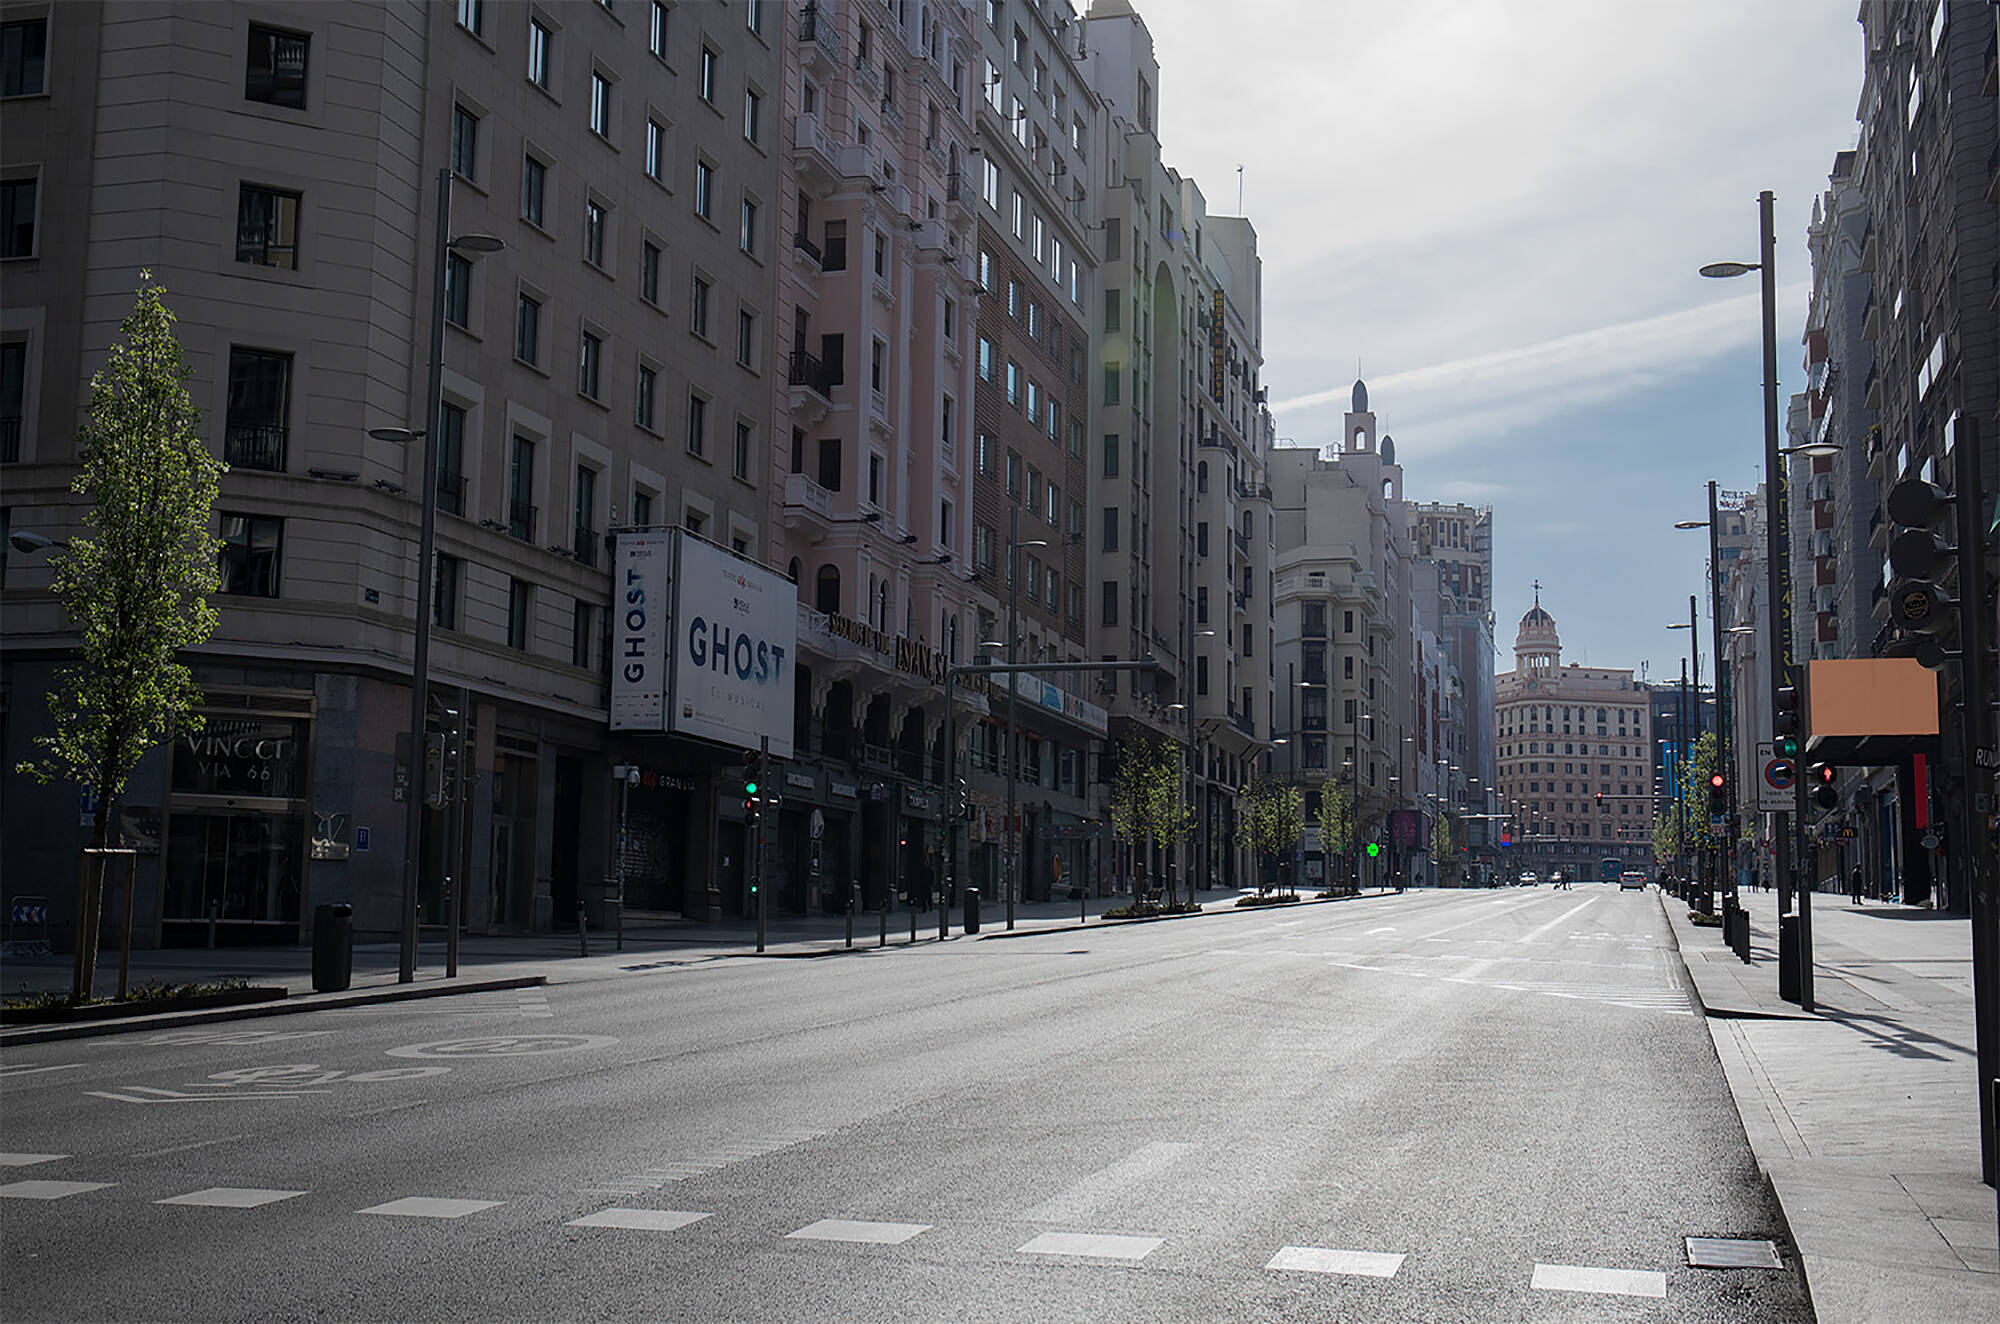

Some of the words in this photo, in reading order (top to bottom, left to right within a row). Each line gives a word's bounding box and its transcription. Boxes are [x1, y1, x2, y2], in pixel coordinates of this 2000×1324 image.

[624, 568, 646, 683] GHOST
[689, 615, 785, 683] GHOST
[187, 736, 284, 760] VINCCI
[247, 764, 271, 781] 66
